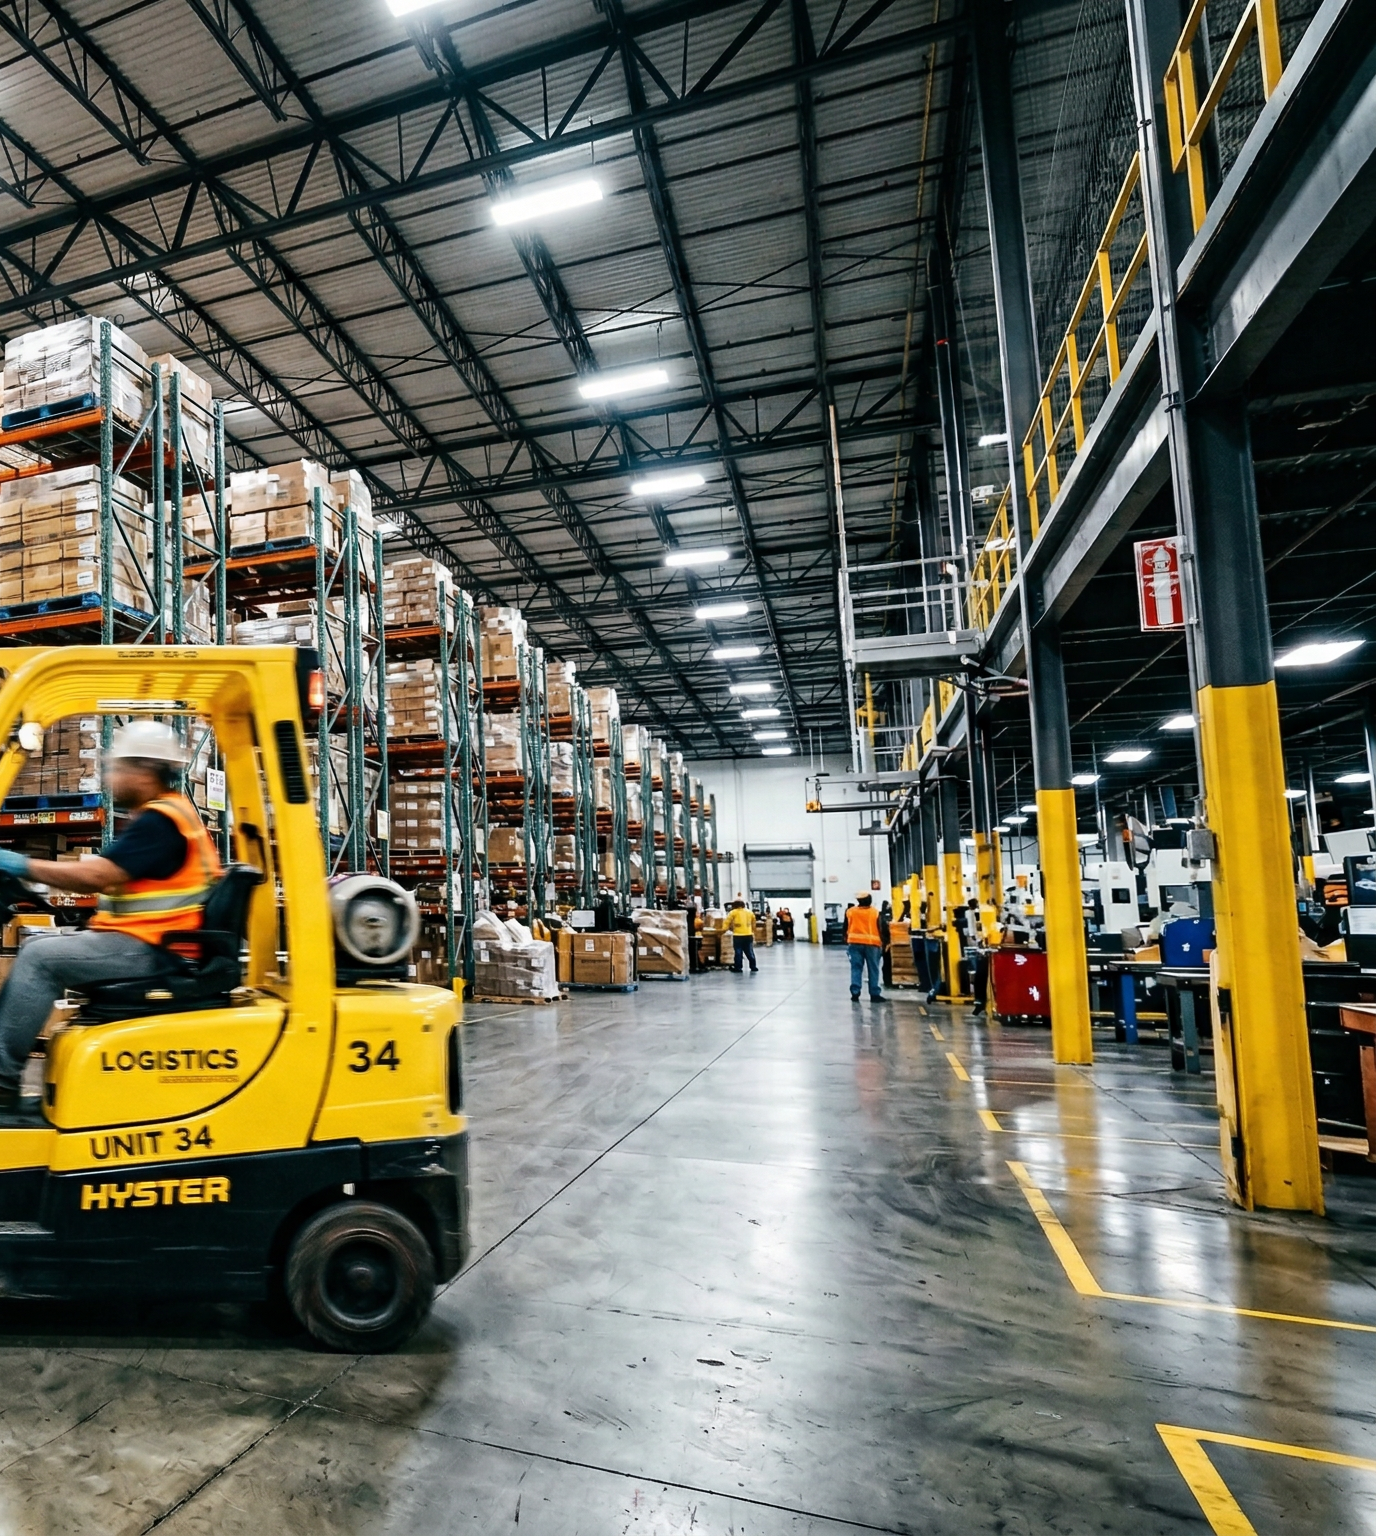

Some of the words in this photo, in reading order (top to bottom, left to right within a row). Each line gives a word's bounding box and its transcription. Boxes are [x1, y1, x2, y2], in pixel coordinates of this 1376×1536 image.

[101, 1049, 239, 1071] LOGISTICS
[348, 1040, 400, 1073] 34
[89, 1131, 164, 1160] UNIT
[174, 1125, 214, 1151] 34
[80, 1176, 231, 1210] HYSTER
